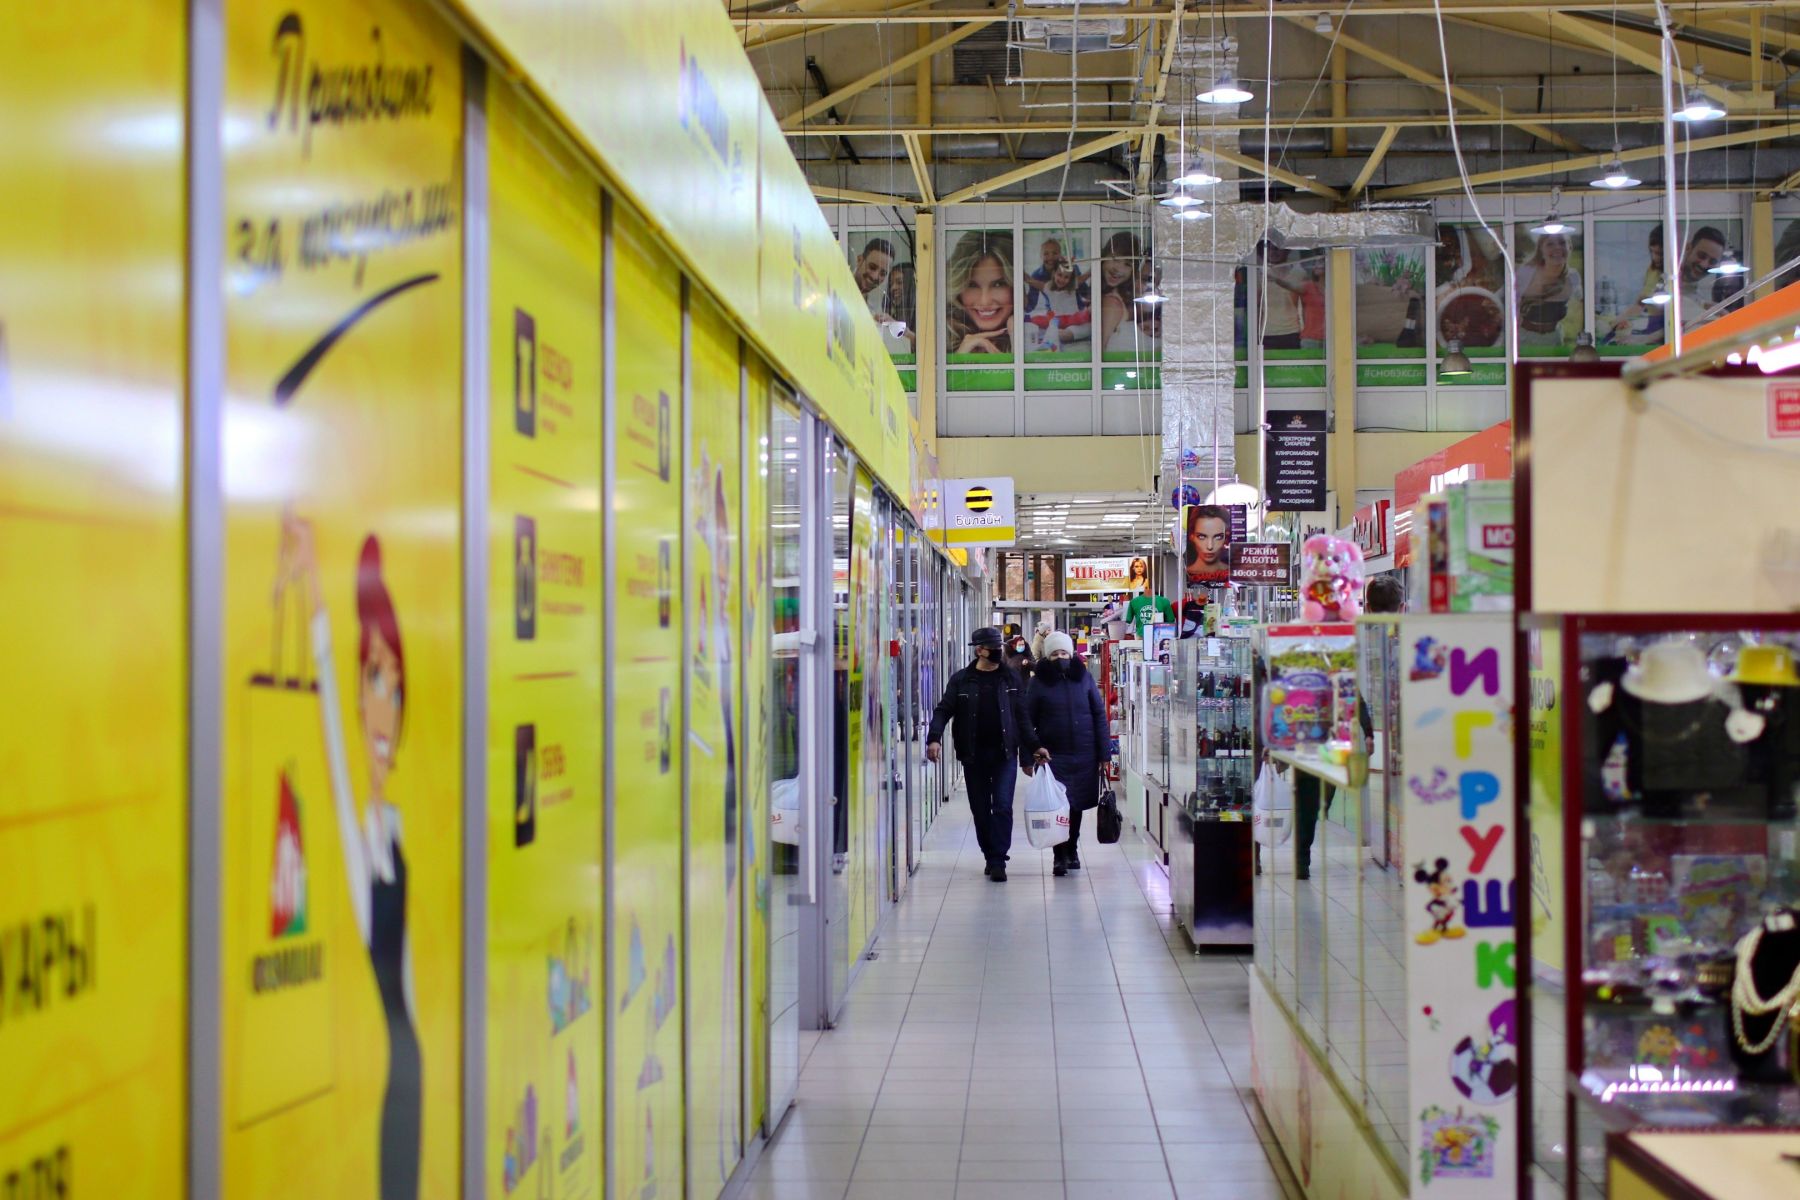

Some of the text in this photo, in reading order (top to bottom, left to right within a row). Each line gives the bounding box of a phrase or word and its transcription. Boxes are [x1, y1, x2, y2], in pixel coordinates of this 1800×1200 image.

[956, 514, 1001, 526] Билайн
[1243, 547, 1278, 555] РЕЖИМ
[1241, 556, 1279, 564] РАБОТЫ
[1070, 565, 1124, 581] Шарм
